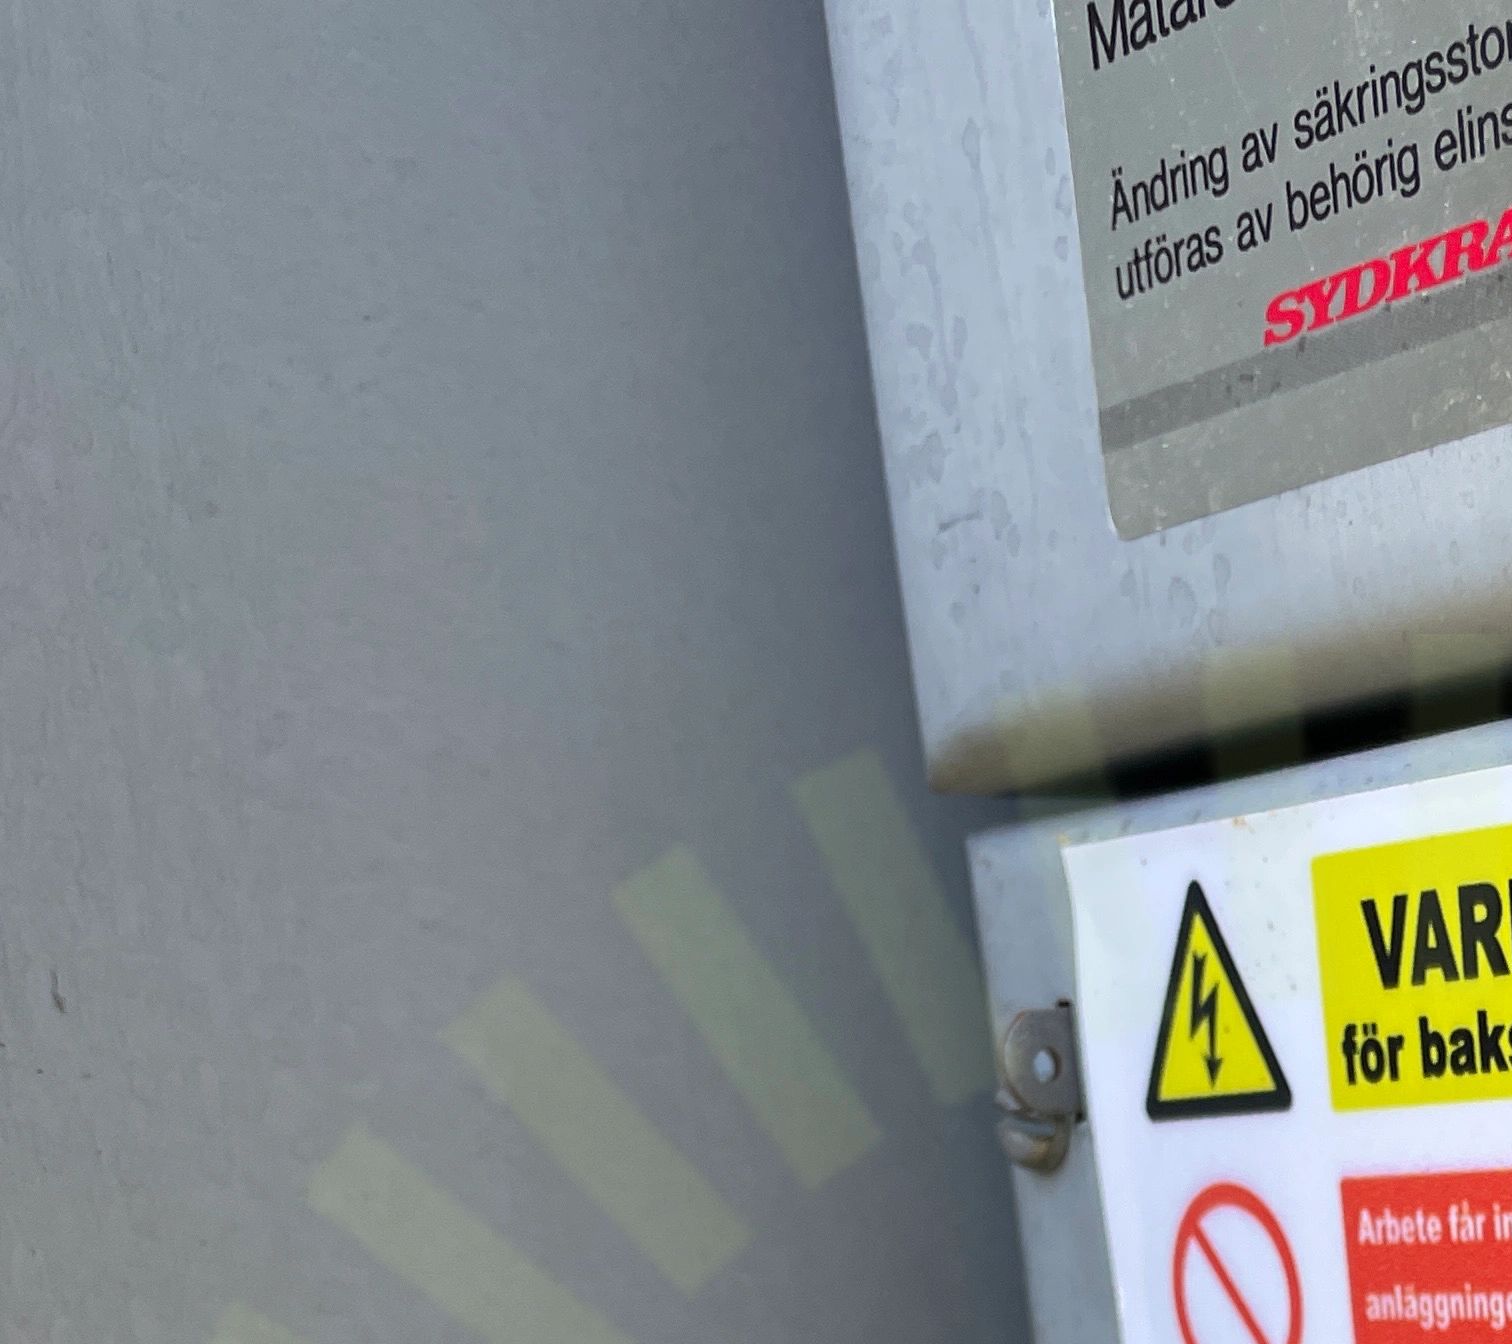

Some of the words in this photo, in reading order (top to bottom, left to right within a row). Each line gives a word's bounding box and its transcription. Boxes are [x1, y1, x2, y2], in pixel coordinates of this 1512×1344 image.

[1110, 144, 1229, 230] Ändring
[1241, 122, 1279, 173] av
[1115, 228, 1224, 299] utföras
[1236, 204, 1275, 252] av
[1288, 139, 1422, 232] behörig
[1340, 1022, 1405, 1086] för
[1358, 1208, 1442, 1246] Arbete
[1449, 1200, 1485, 1242] får
